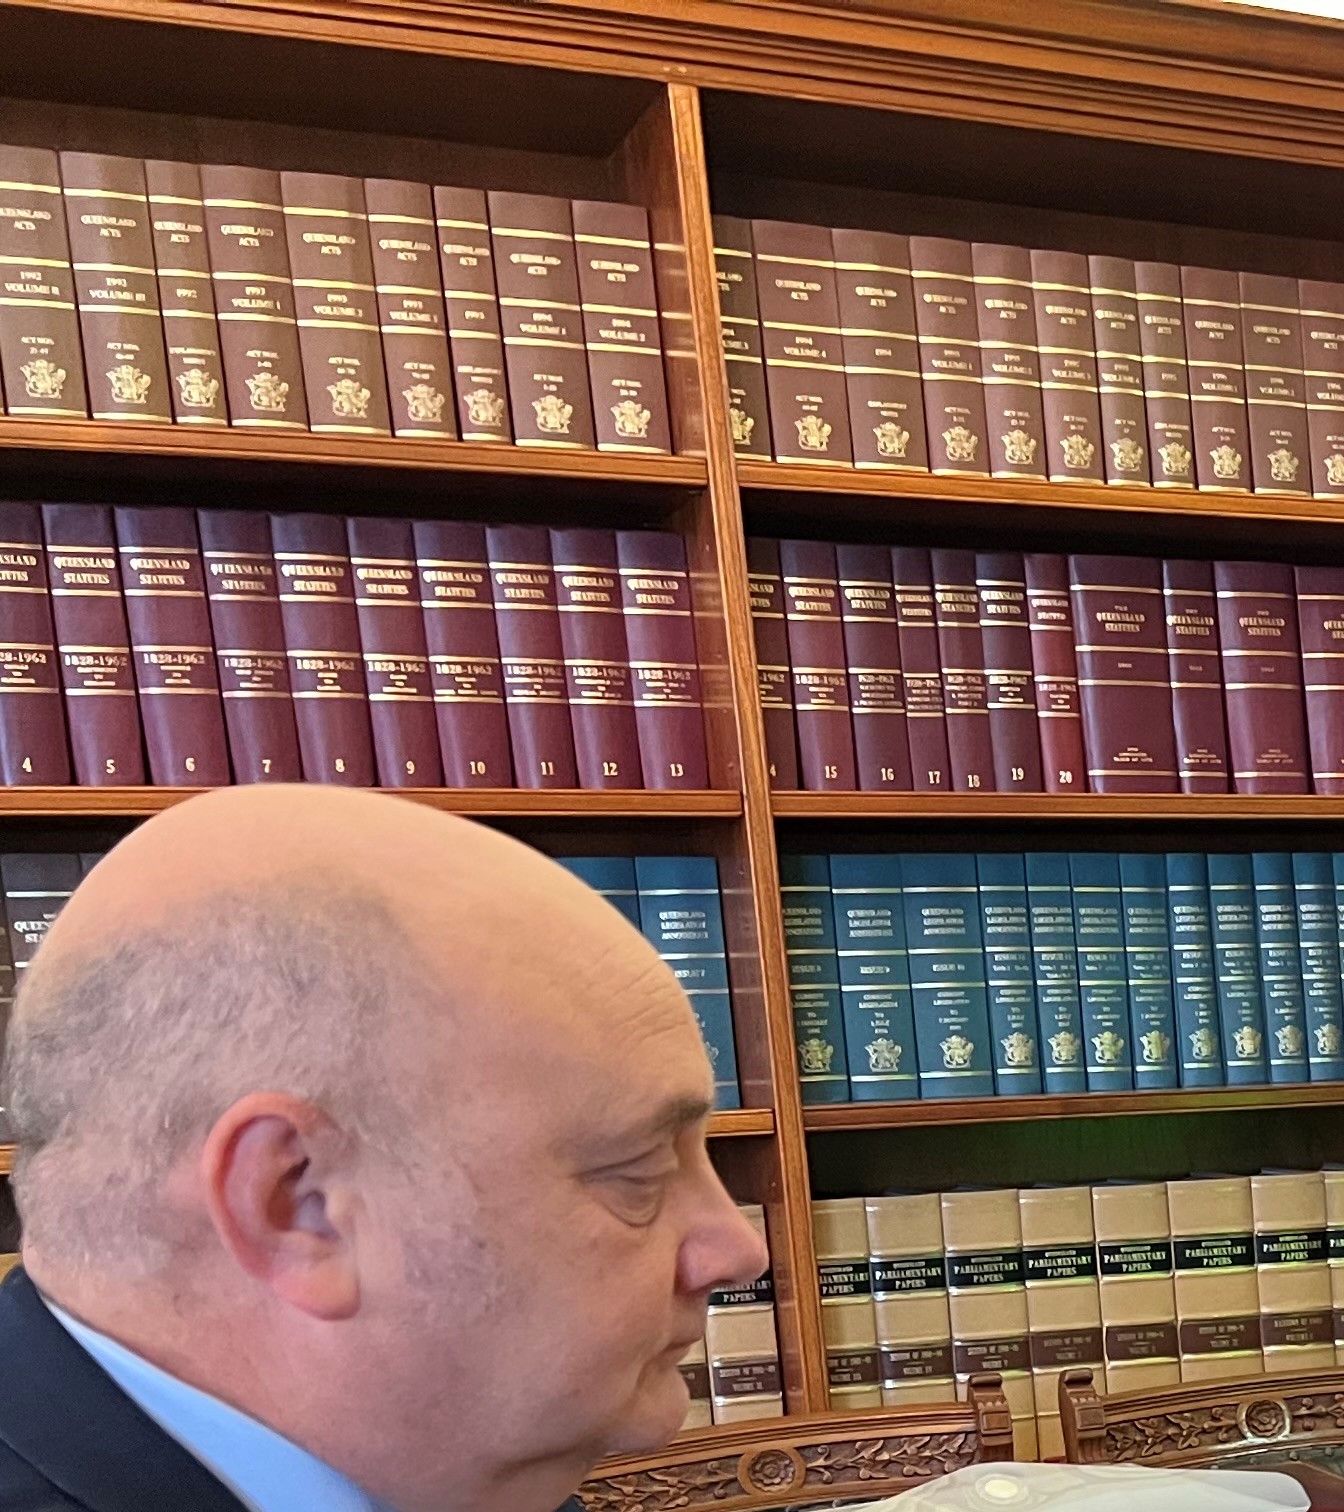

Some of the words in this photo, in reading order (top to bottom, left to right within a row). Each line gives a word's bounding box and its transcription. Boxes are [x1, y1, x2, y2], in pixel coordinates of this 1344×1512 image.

[81, 214, 136, 228] QUEENSLAND
[5, 283, 48, 295] VOLUME
[89, 289, 133, 301] VOLUME
[54, 557, 115, 570] QUEENSLAND
[130, 558, 190, 570] QUEENSLAND
[211, 564, 273, 576] QUEENSLAND
[281, 564, 344, 577] QUEENSLAND
[356, 568, 412, 580] QUEENSLAND
[64, 573, 109, 585] STATUTES
[140, 574, 185, 586] STATUTES
[422, 570, 483, 583] QUEENSLAND
[495, 573, 549, 585] QUEENSLAND
[562, 576, 614, 588] QUEENSLAND
[222, 580, 265, 591] STATUTES
[293, 580, 337, 592] STATUTES
[365, 583, 409, 595] STATUTES
[627, 578, 678, 590] QUEENSLAND
[434, 586, 476, 598] STATUTES
[504, 588, 545, 599] STATUTES
[570, 591, 610, 602] STATUTES
[636, 593, 675, 605] STATUTES
[1096, 612, 1145, 623] QUEENSLAND
[1166, 614, 1214, 626] QUEENSLAND
[1239, 616, 1285, 627] QUEENSLAND
[1105, 623, 1140, 632] STATUTES
[1176, 626, 1210, 636] STATUTES
[1247, 627, 1281, 637] STATUTES
[22, 757, 32, 773] 4
[106, 759, 115, 773] 5
[185, 757, 195, 771] 6
[262, 759, 271, 773] 7
[335, 758, 345, 773] 8
[406, 760, 415, 774] 9
[470, 761, 486, 775] 10
[540, 762, 555, 775] 11
[603, 762, 618, 776] 12
[670, 763, 684, 776] 13
[825, 765, 838, 779] 15
[881, 768, 894, 782] 16
[928, 772, 940, 784] 17
[1011, 768, 1024, 782] 19
[1059, 771, 1073, 784] 20
[967, 775, 980, 789] 18
[1185, 1246, 1247, 1258] PARLIAMENTARY
[1263, 1240, 1322, 1253] PARLIAMENTARY
[1028, 1256, 1092, 1268] PARLIAMENTARY
[1103, 1251, 1167, 1264] PARLIAMENTARY
[1203, 1256, 1232, 1267] PAPERS
[1281, 1252, 1308, 1261] PAPERS
[875, 1266, 942, 1281] PARLIAMENTARY
[954, 1261, 1019, 1275] PARLIAMENTARY
[1047, 1267, 1077, 1278] PAPERS
[1122, 1263, 1151, 1273] PAPERS
[973, 1273, 1004, 1284] PAPERS
[822, 1284, 855, 1295] PAPERS
[895, 1280, 926, 1290] PAPERS
[723, 1293, 757, 1303] PAPERS
